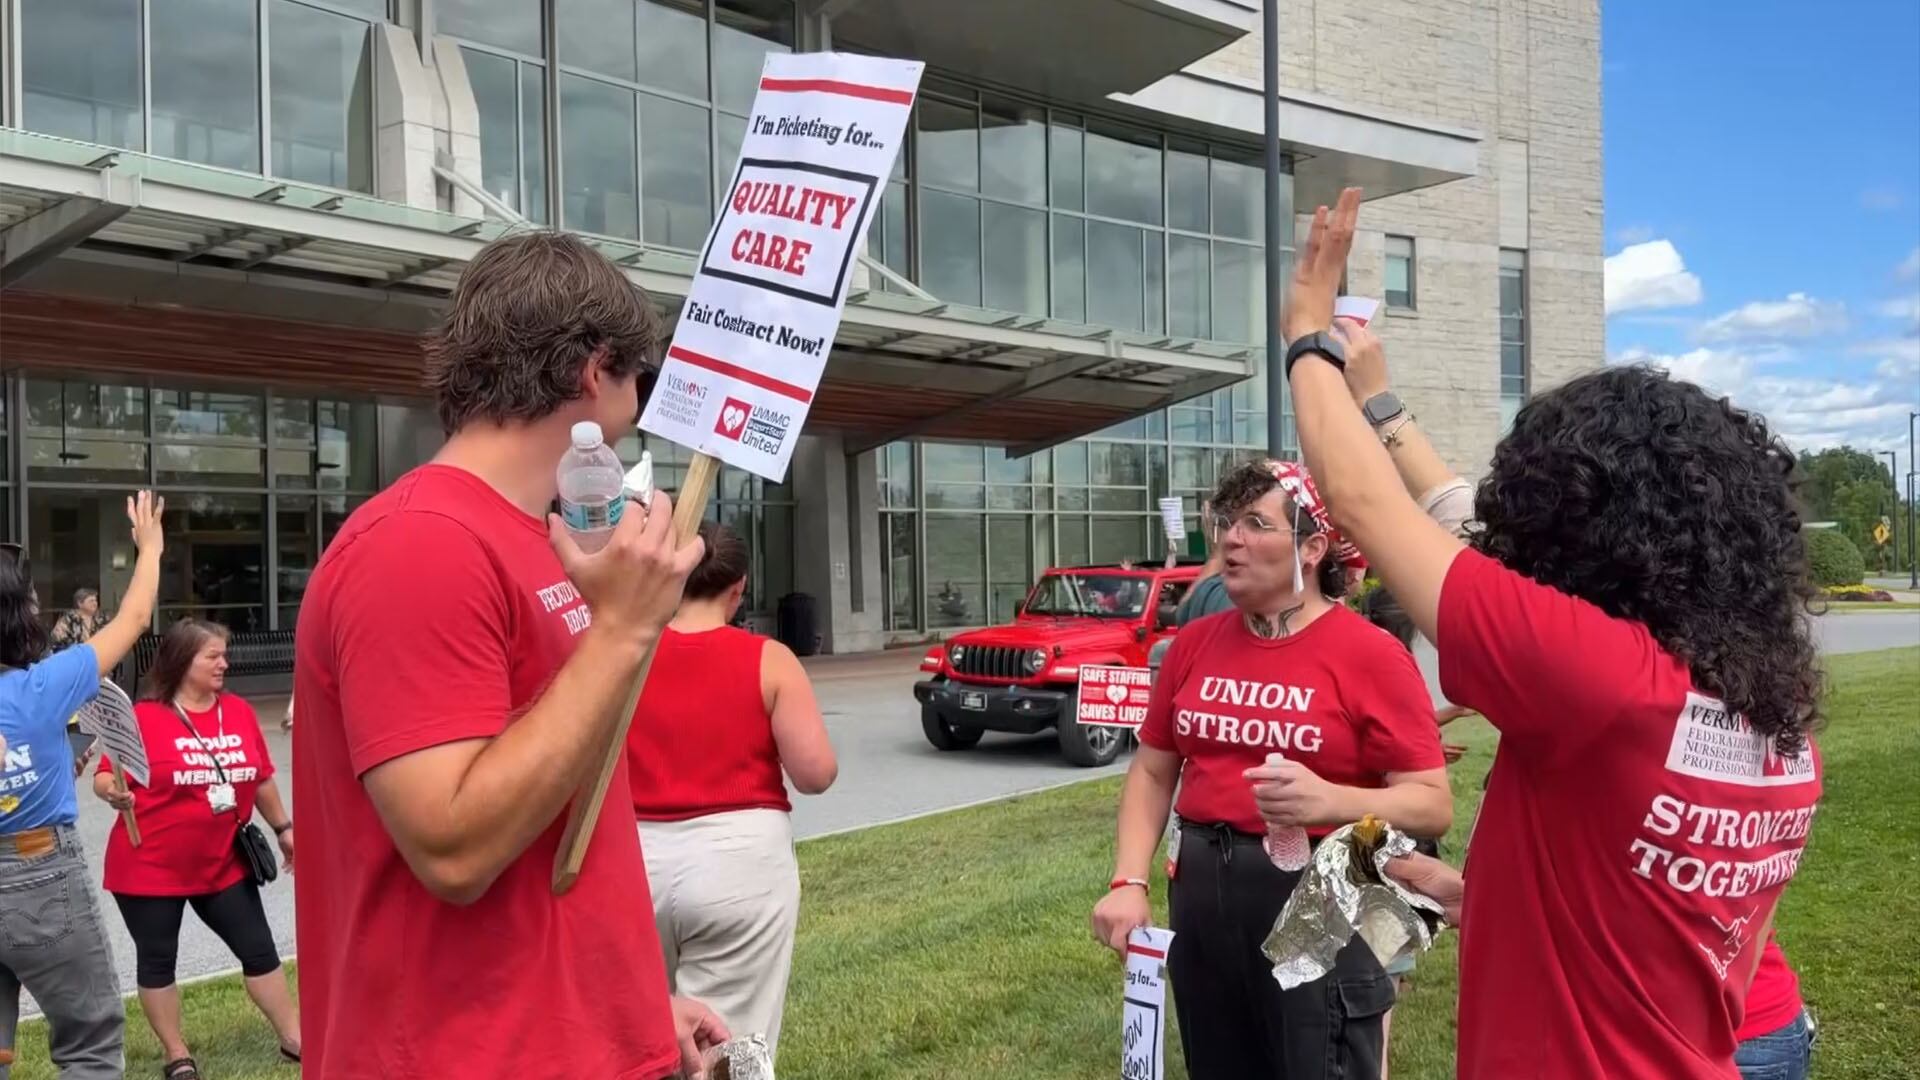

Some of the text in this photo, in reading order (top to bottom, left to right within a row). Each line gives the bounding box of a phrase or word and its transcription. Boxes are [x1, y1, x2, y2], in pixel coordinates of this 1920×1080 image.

[752, 115, 884, 149] I'm Picketing for...
[733, 180, 856, 230] QUALITY
[731, 228, 813, 276] CARE
[686, 302, 825, 357] Fair Contract Now!
[742, 431, 782, 455] United
[1083, 668, 1107, 683] SAFE
[1200, 675, 1315, 712] UNION
[1080, 703, 1116, 720] SAVES
[175, 734, 242, 751] PROUD
[1176, 708, 1324, 754] STRONG
[1687, 727, 1750, 750] FEDERATION
[182, 750, 246, 768] UNION
[1685, 739, 1726, 759] NURSES
